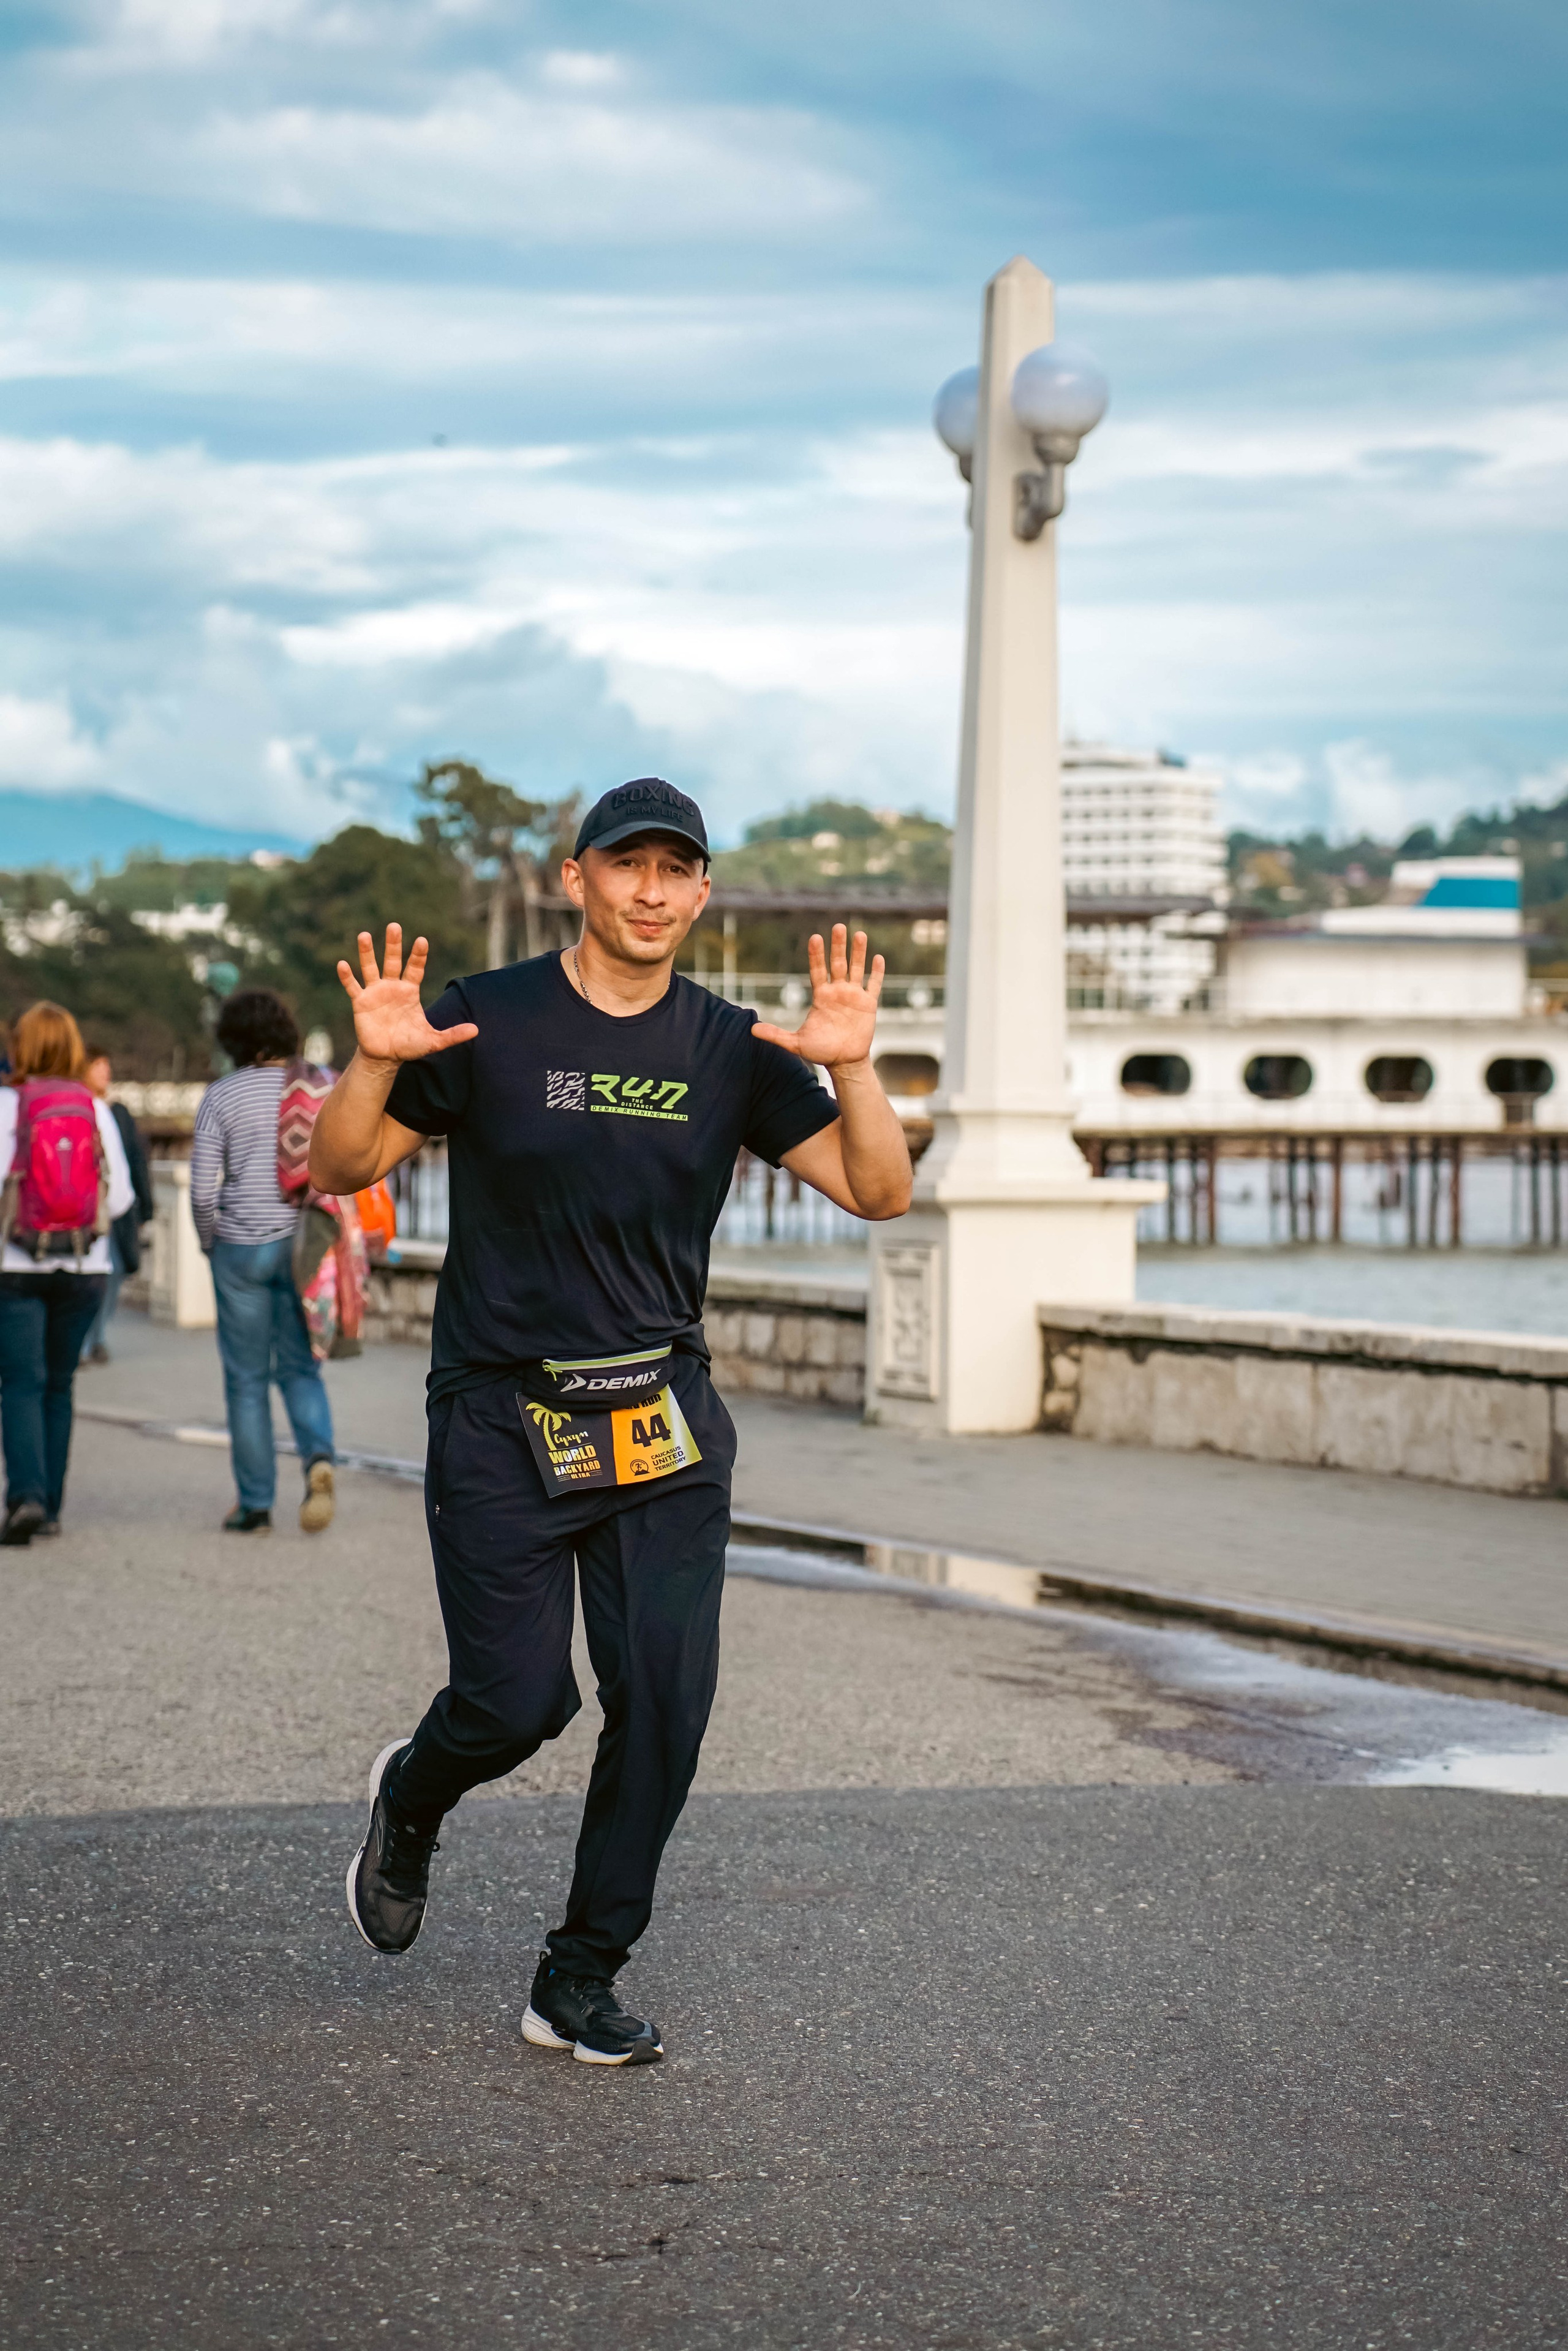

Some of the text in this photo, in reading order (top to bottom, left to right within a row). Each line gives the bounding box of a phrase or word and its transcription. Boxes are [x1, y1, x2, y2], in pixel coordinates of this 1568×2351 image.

[612, 785, 695, 816] BOXING
[662, 808, 683, 822] LIFE
[623, 1108, 661, 1117] RUNNING
[587, 1368, 662, 1390] DEMIX
[631, 1413, 671, 1447] 44
[548, 1445, 597, 1464] WORLD
[650, 1446, 681, 1460] CAUCASUS
[652, 1451, 684, 1466] UNITED
[554, 1460, 601, 1476] BACKYARD
[655, 1456, 686, 1471] TERRITORY
